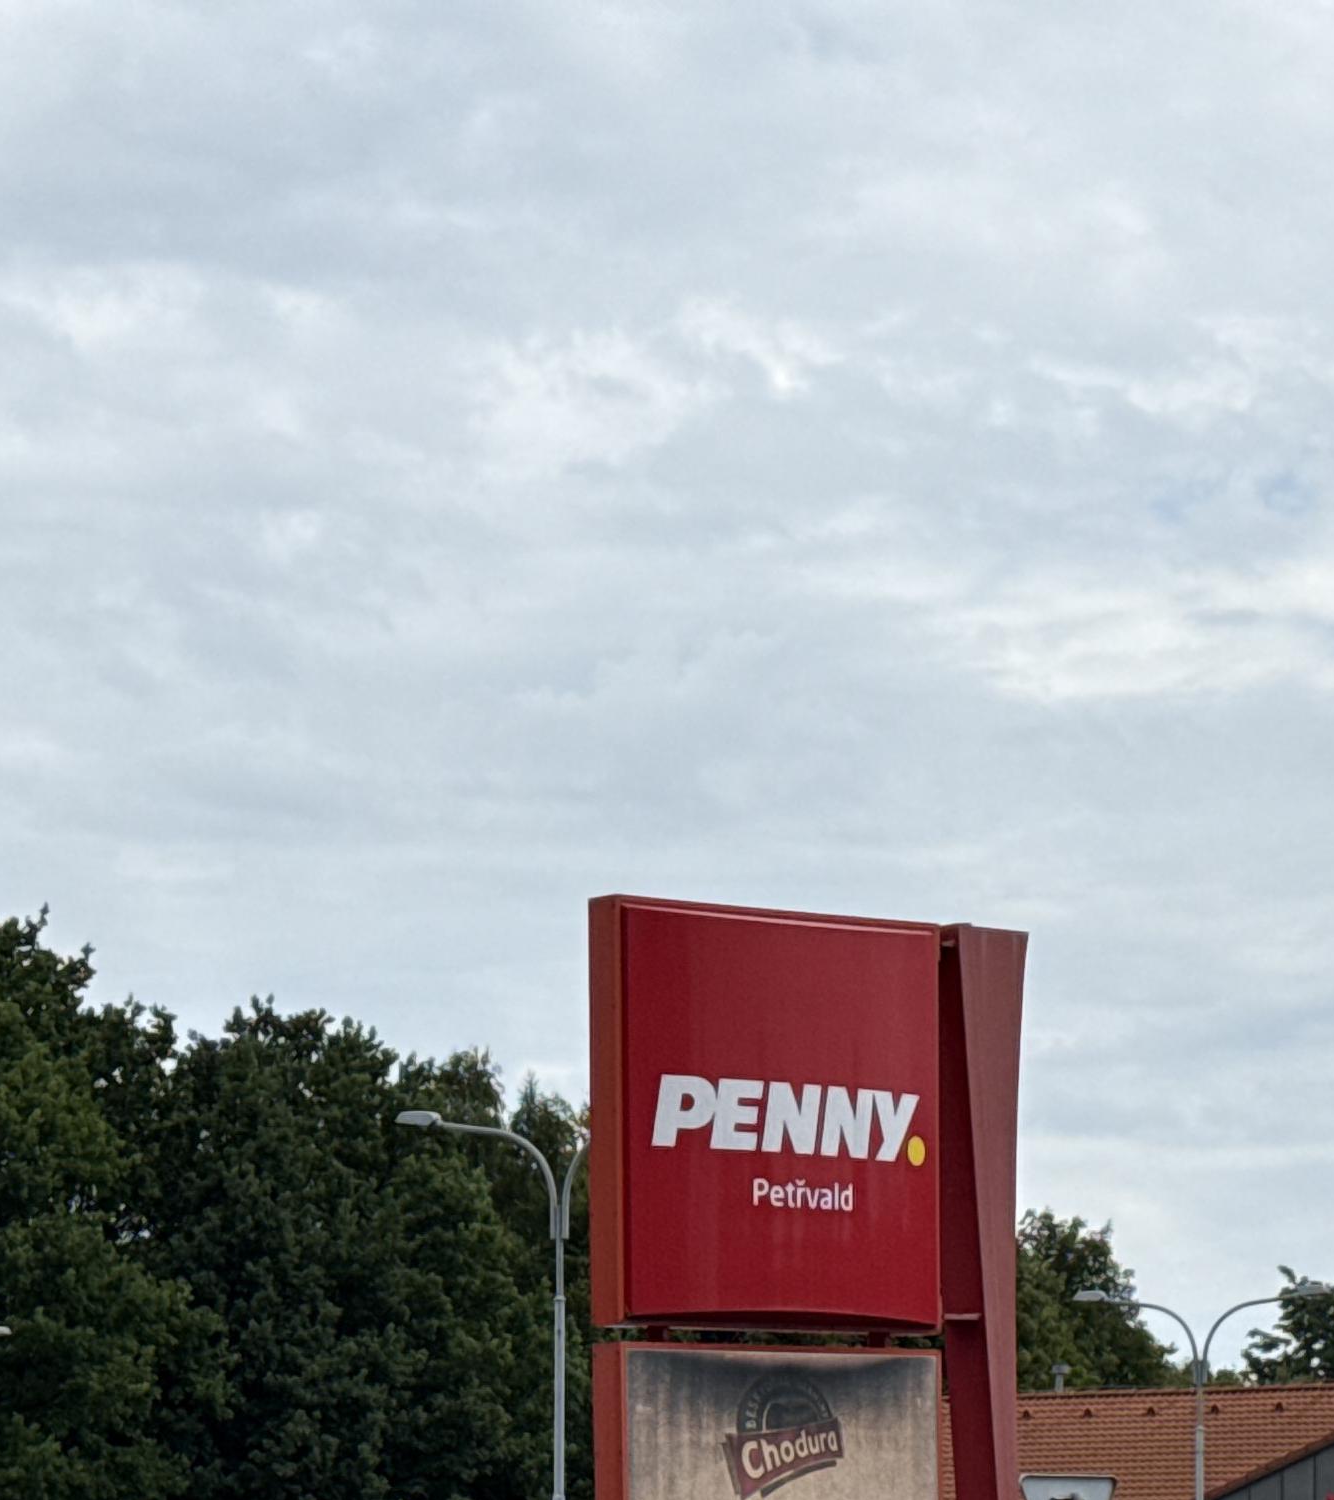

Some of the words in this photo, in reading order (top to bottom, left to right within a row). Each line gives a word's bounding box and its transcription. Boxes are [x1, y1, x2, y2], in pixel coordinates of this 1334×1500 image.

[651, 1074, 926, 1167] PENNY.
[752, 1178, 854, 1212] Petřvald
[742, 1430, 838, 1479] Chodura
